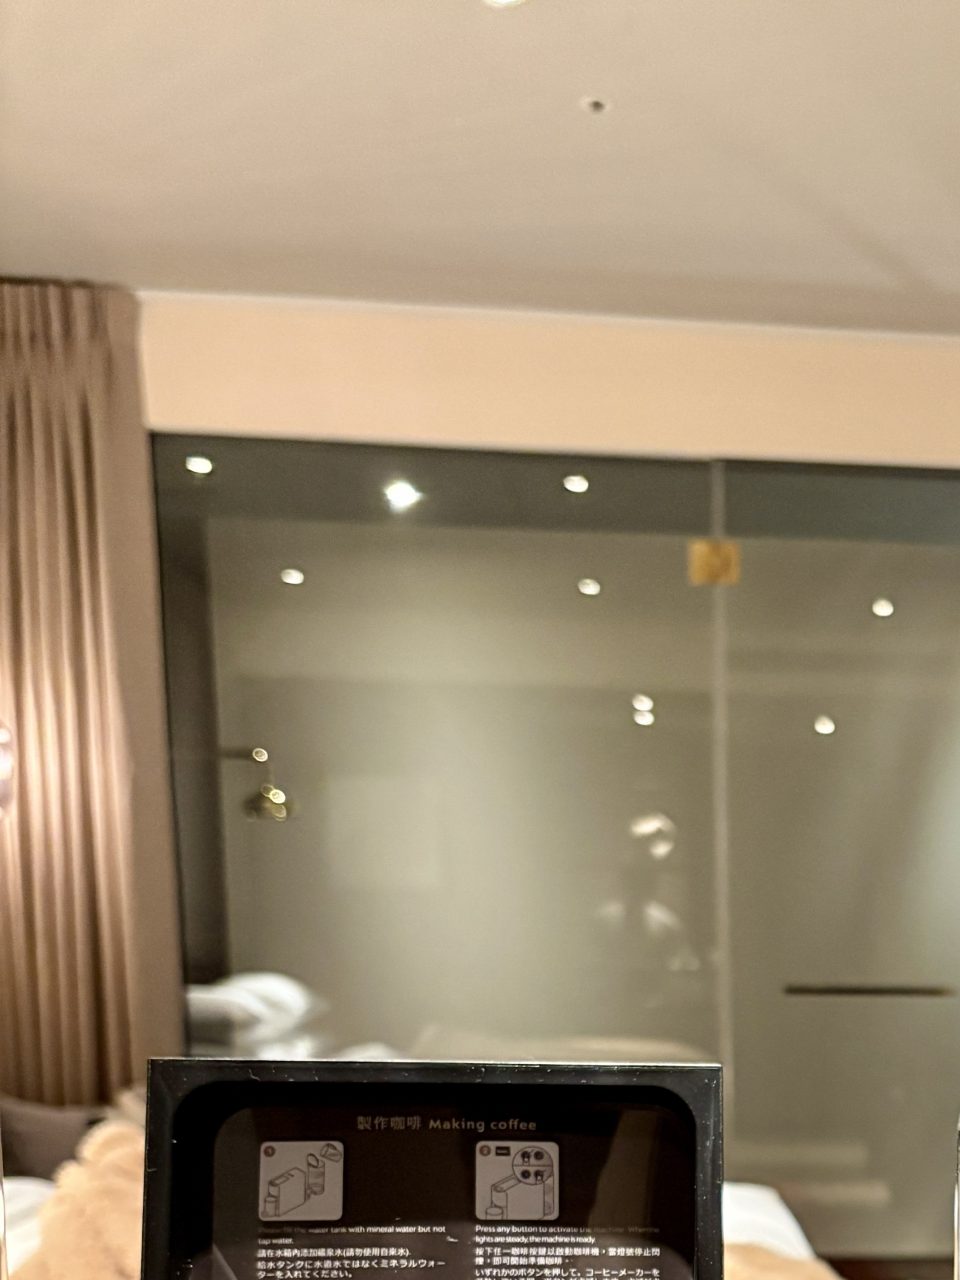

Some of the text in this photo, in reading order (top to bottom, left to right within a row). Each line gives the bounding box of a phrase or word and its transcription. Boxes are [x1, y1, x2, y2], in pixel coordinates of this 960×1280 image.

[357, 1116, 537, 1132] 製作咖啡 Making coffee
[366, 1225, 395, 1233] mineral
[417, 1225, 431, 1233] but
[432, 1225, 446, 1233] not
[475, 1224, 496, 1233] Press
[496, 1225, 511, 1234] any
[511, 1225, 538, 1233] button
